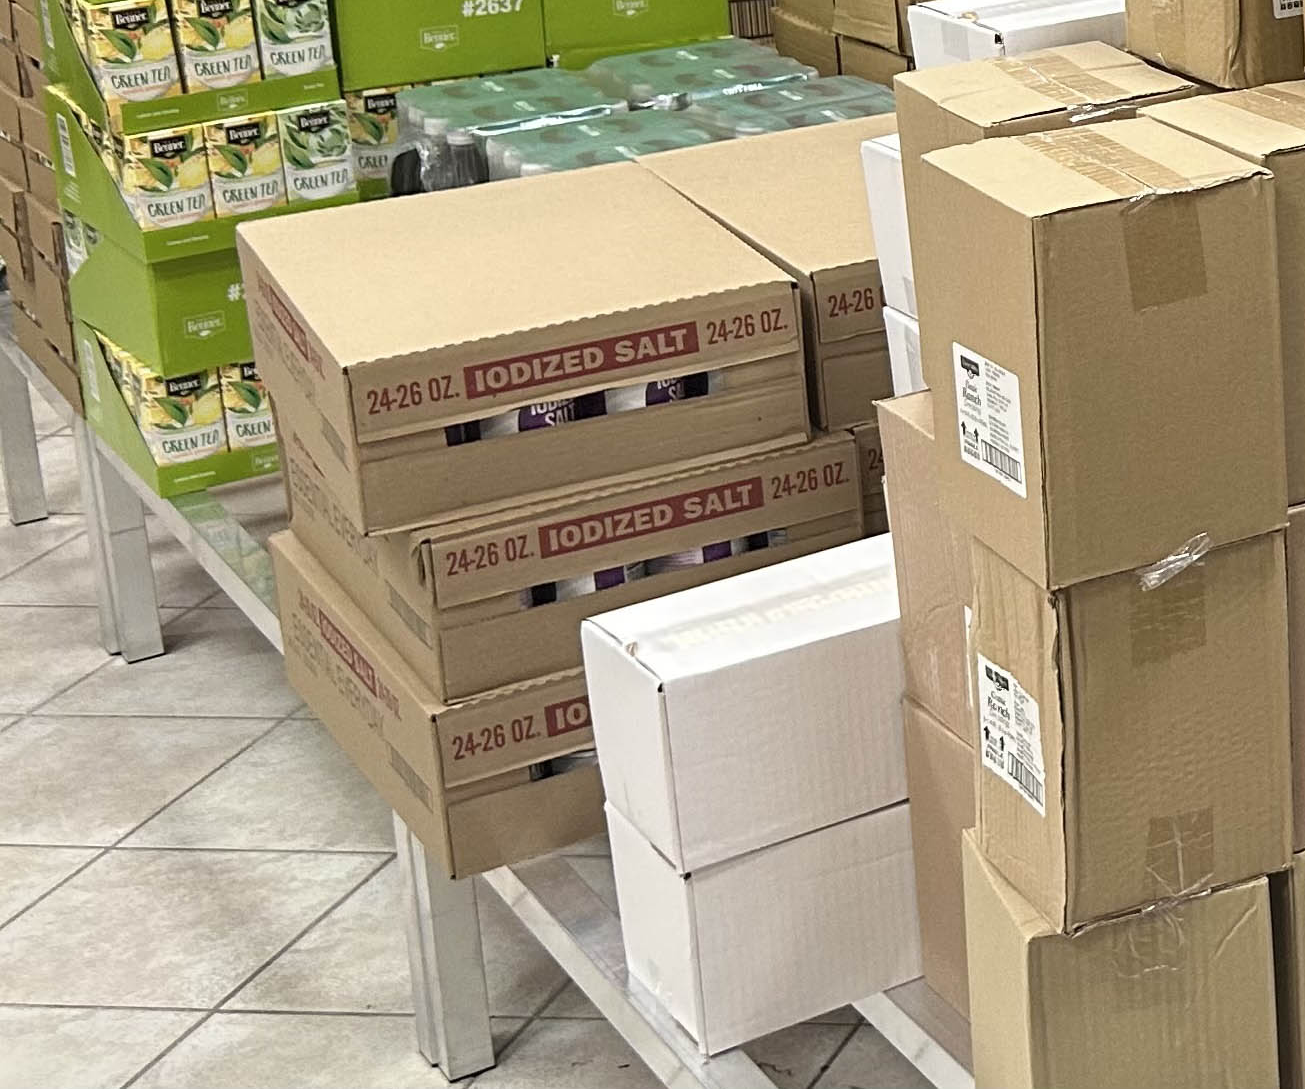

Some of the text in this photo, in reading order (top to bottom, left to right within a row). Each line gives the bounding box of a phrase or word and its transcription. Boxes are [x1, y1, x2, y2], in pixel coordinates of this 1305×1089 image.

[195, 60, 232, 76] GREEN
[270, 50, 306, 65] GREEN
[111, 73, 149, 89] GREEN
[222, 186, 258, 204] GREEN
[294, 173, 328, 190] GREEN
[147, 199, 183, 217] GREEN
[828, 288, 874, 318] 24-26
[706, 309, 789, 346] 24-26 OZ.
[475, 328, 688, 393] IODIZED SALT
[367, 375, 461, 415] 24-26 OZ.
[162, 437, 199, 454] GREEN
[771, 461, 850, 500] 24-26 OZ.
[548, 485, 754, 554] IODIZED SALT
[446, 535, 534, 577] 24-26 OZ.
[452, 717, 541, 761] 24-26 OZ.
